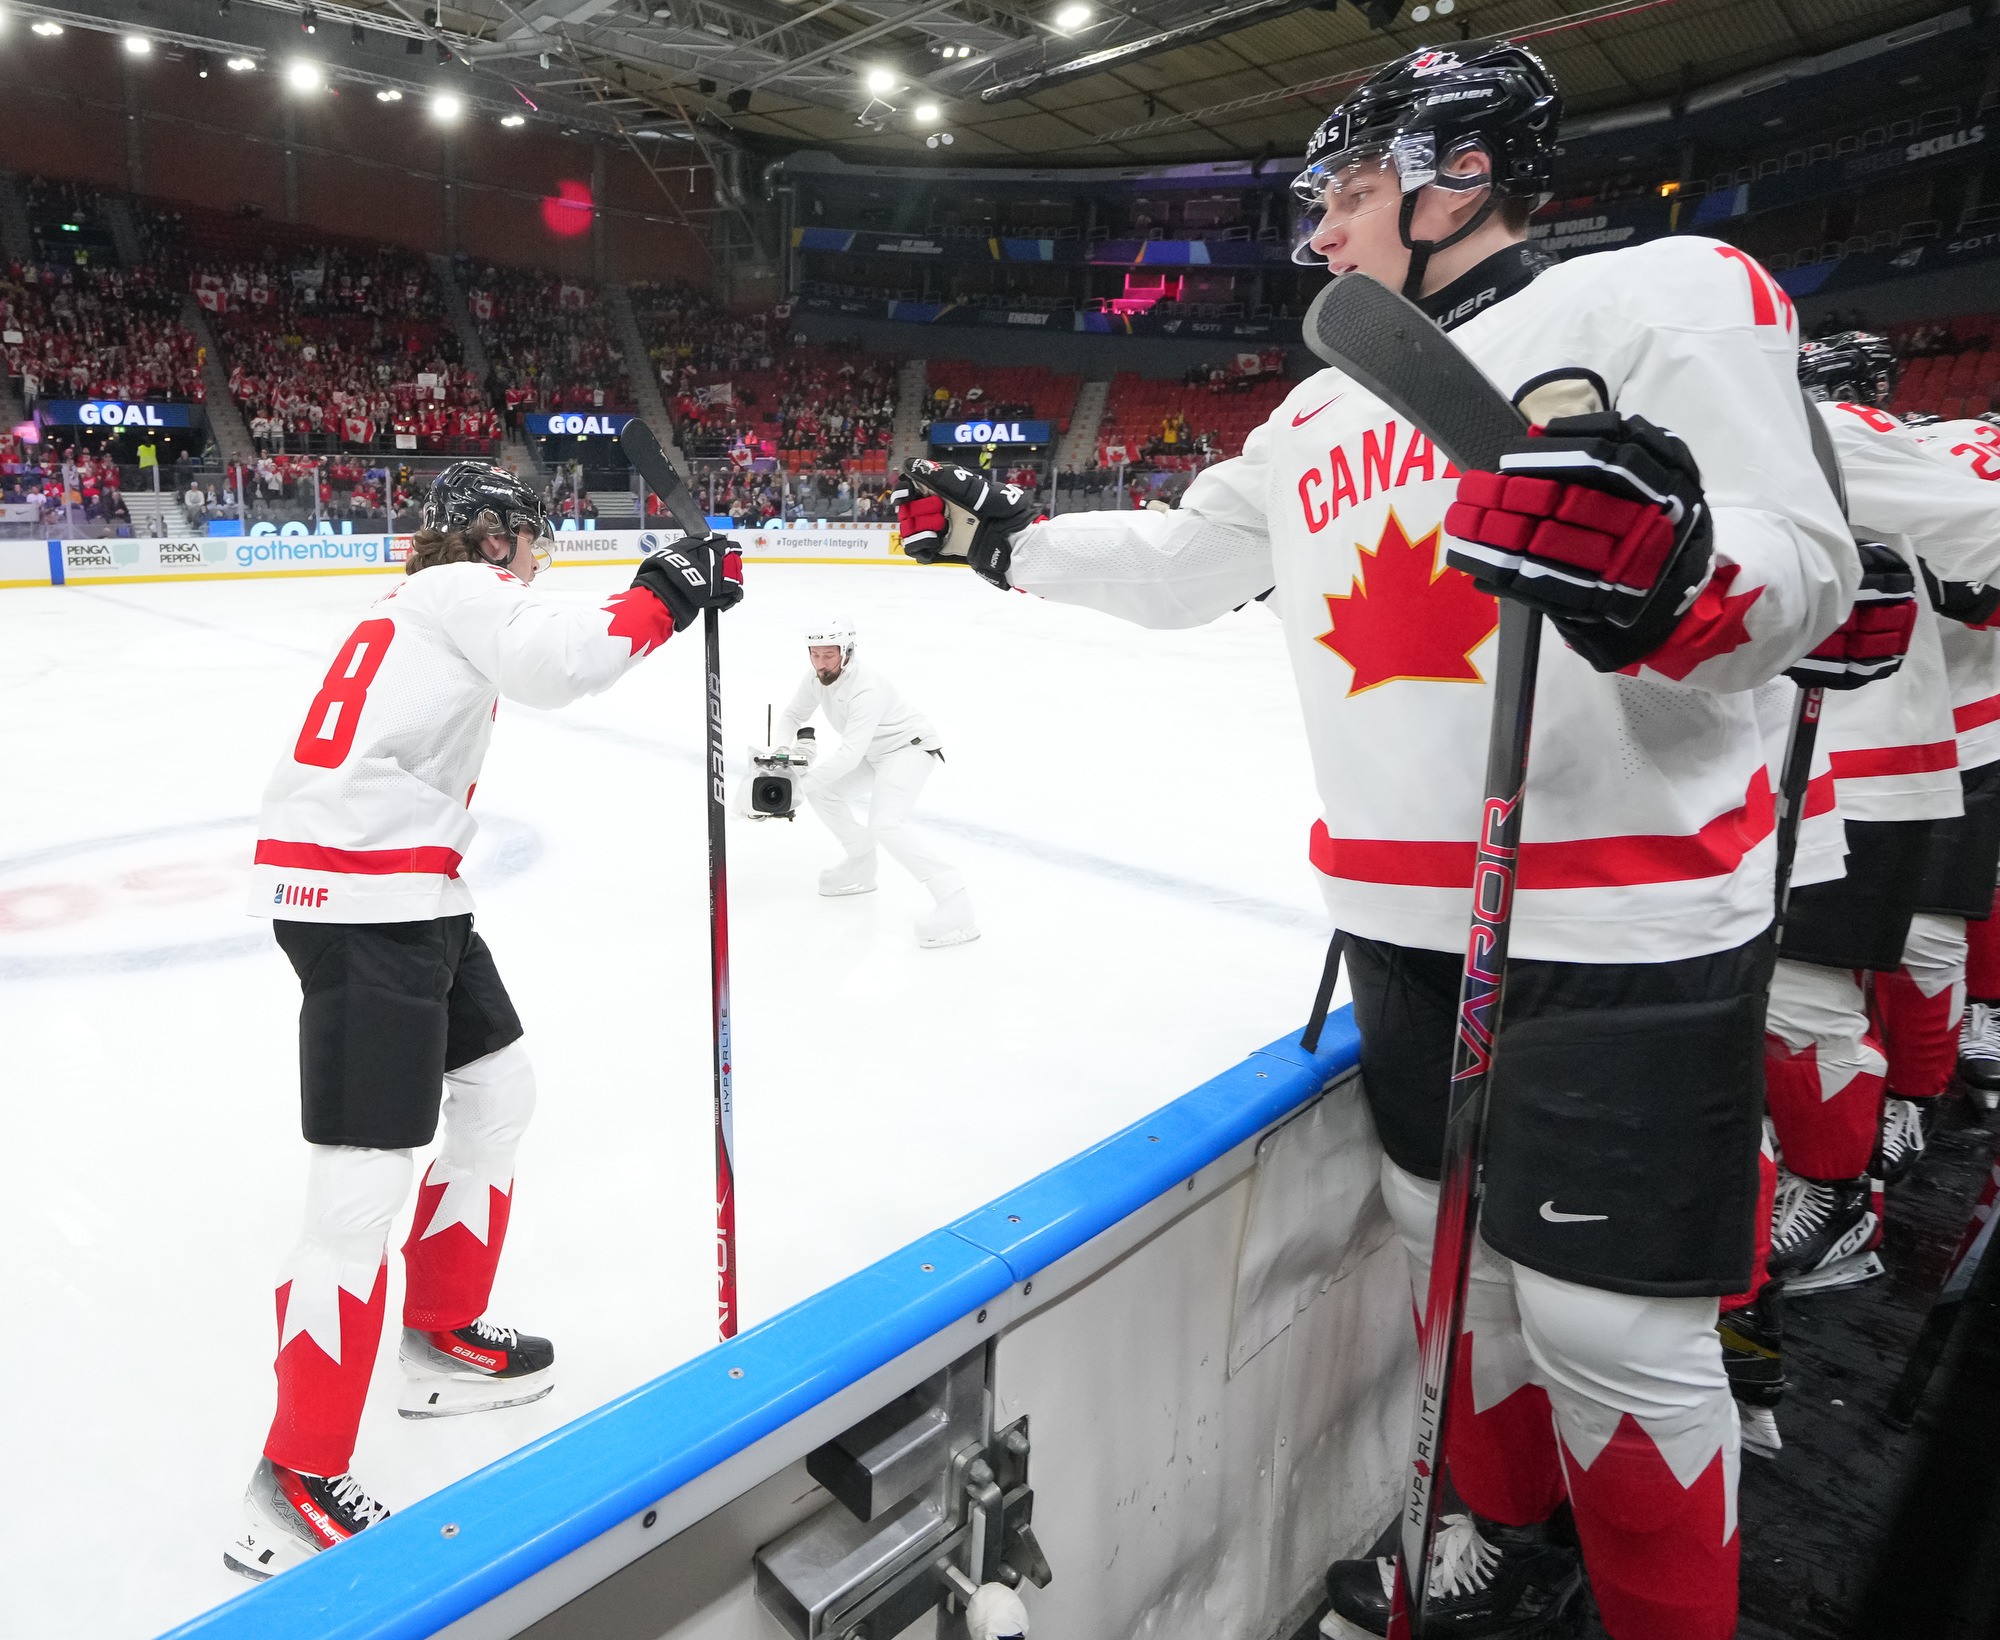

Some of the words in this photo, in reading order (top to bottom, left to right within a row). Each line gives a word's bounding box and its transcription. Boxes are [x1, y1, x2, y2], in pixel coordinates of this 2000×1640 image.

[1426, 88, 1493, 106] BAUER
[1906, 125, 1985, 161] SKILLS
[1433, 287, 1497, 328] UER
[1008, 312, 1050, 325] ENERGY
[79, 403, 163, 426] GOAL
[548, 415, 615, 435] GOAL
[954, 424, 1025, 443] GOAL
[1298, 420, 1462, 534] CANA
[67, 545, 110, 555] PENGA
[159, 542, 199, 553] PENGA
[236, 539, 378, 567] gothenburg
[776, 537, 868, 549] #Together4Integrity
[68, 556, 111, 566] PEPPEN
[160, 553, 201, 563] PEPPEN
[389, 550, 407, 561] SWE
[294, 618, 395, 769] 8
[285, 884, 329, 908] IIHF
[1450, 782, 1526, 1081] VAPOR
[452, 1345, 497, 1367] BAUER
